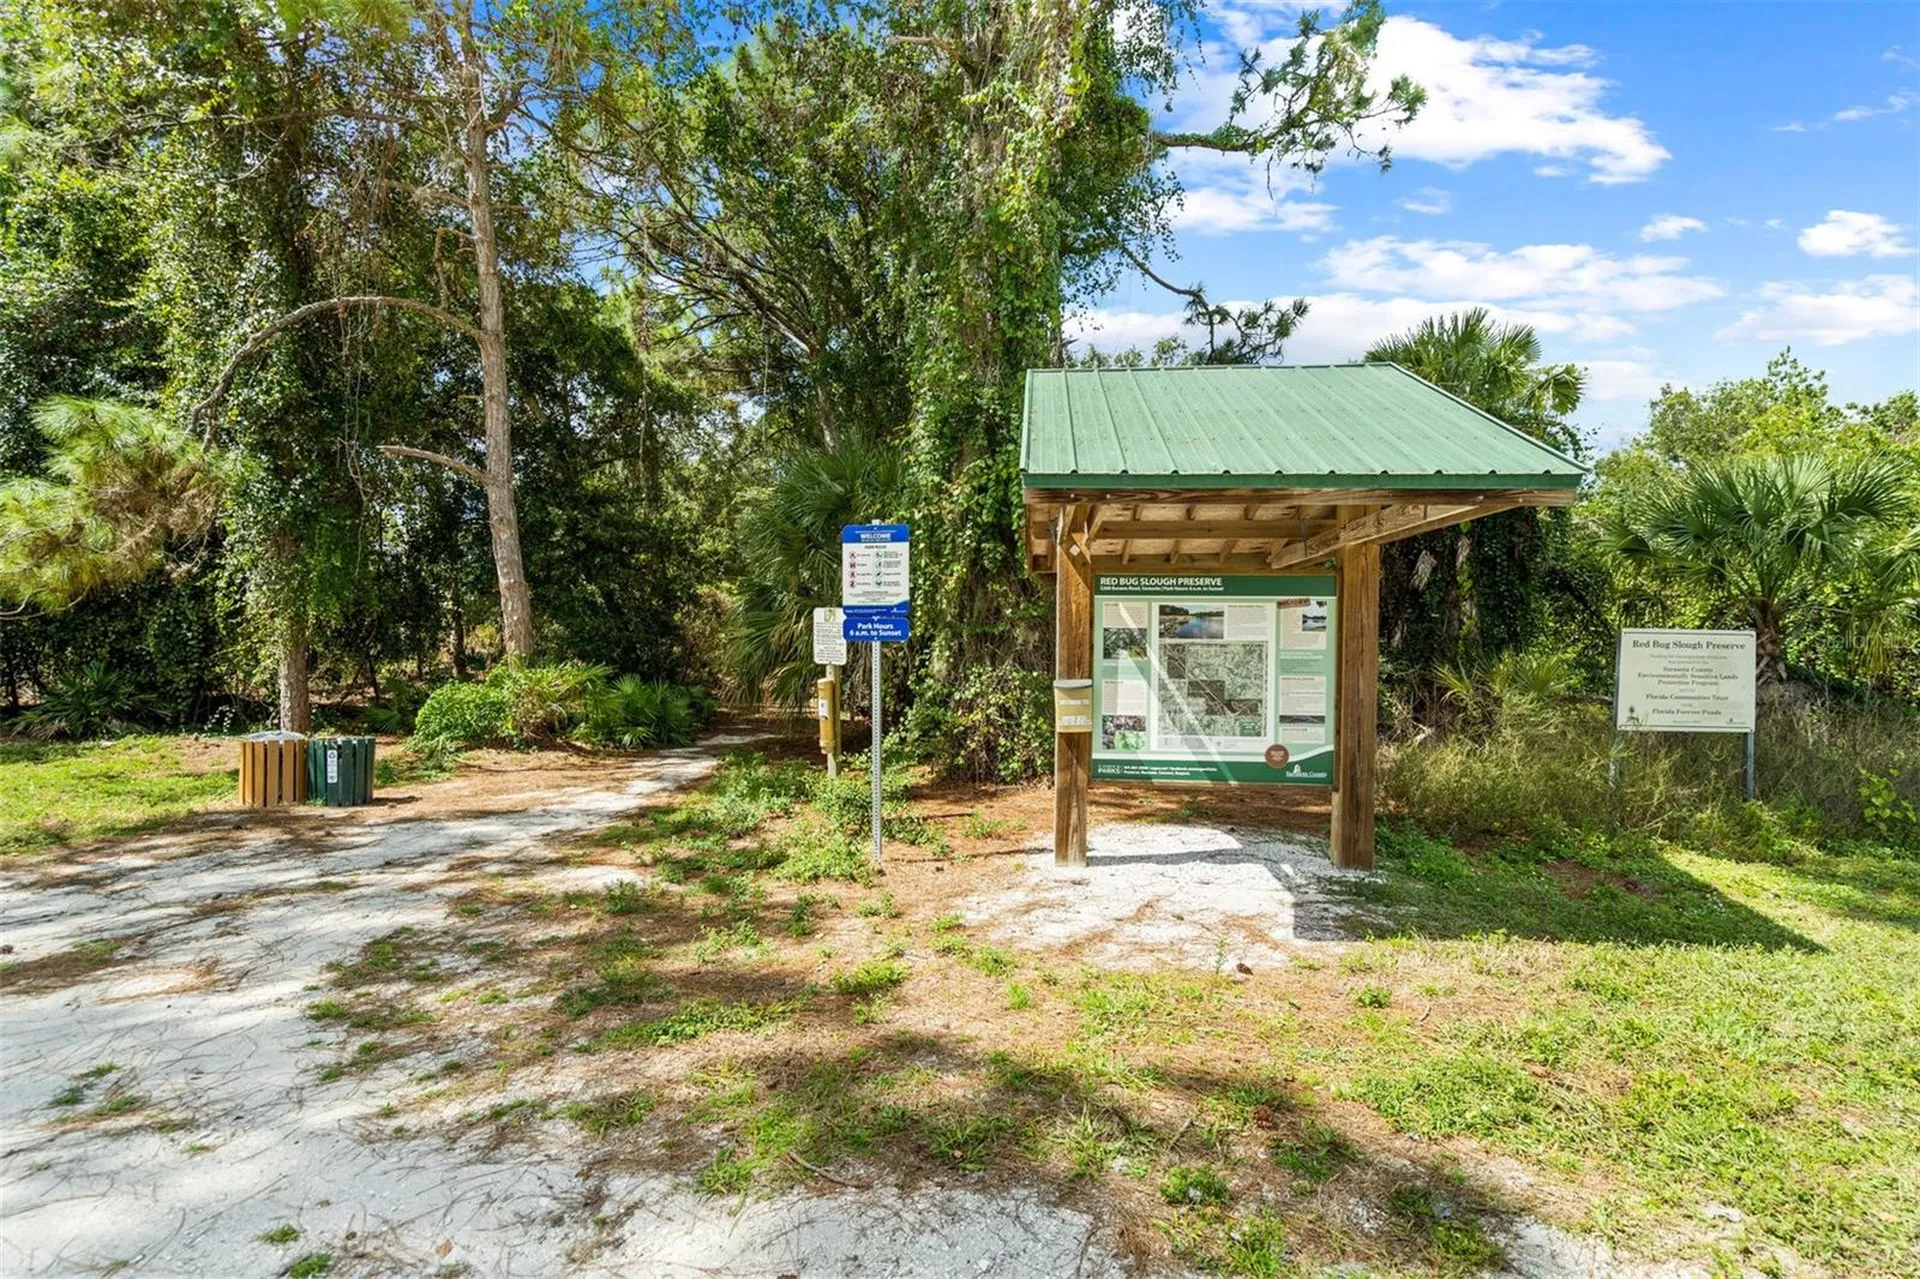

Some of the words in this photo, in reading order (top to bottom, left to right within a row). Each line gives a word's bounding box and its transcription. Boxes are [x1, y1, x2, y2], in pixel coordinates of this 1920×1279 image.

[1100, 577, 1118, 586] RED
[1119, 577, 1139, 586] BUG
[1140, 577, 1177, 586] SLOUGH
[1177, 577, 1223, 586] PRESERVE
[857, 622, 872, 630] Park
[873, 622, 894, 630] Hours
[879, 629, 902, 637] Sunset
[1632, 640, 1650, 648] Red
[1652, 640, 1671, 650] Bug
[1672, 640, 1703, 650] Slough
[1706, 641, 1746, 649] Preserve
